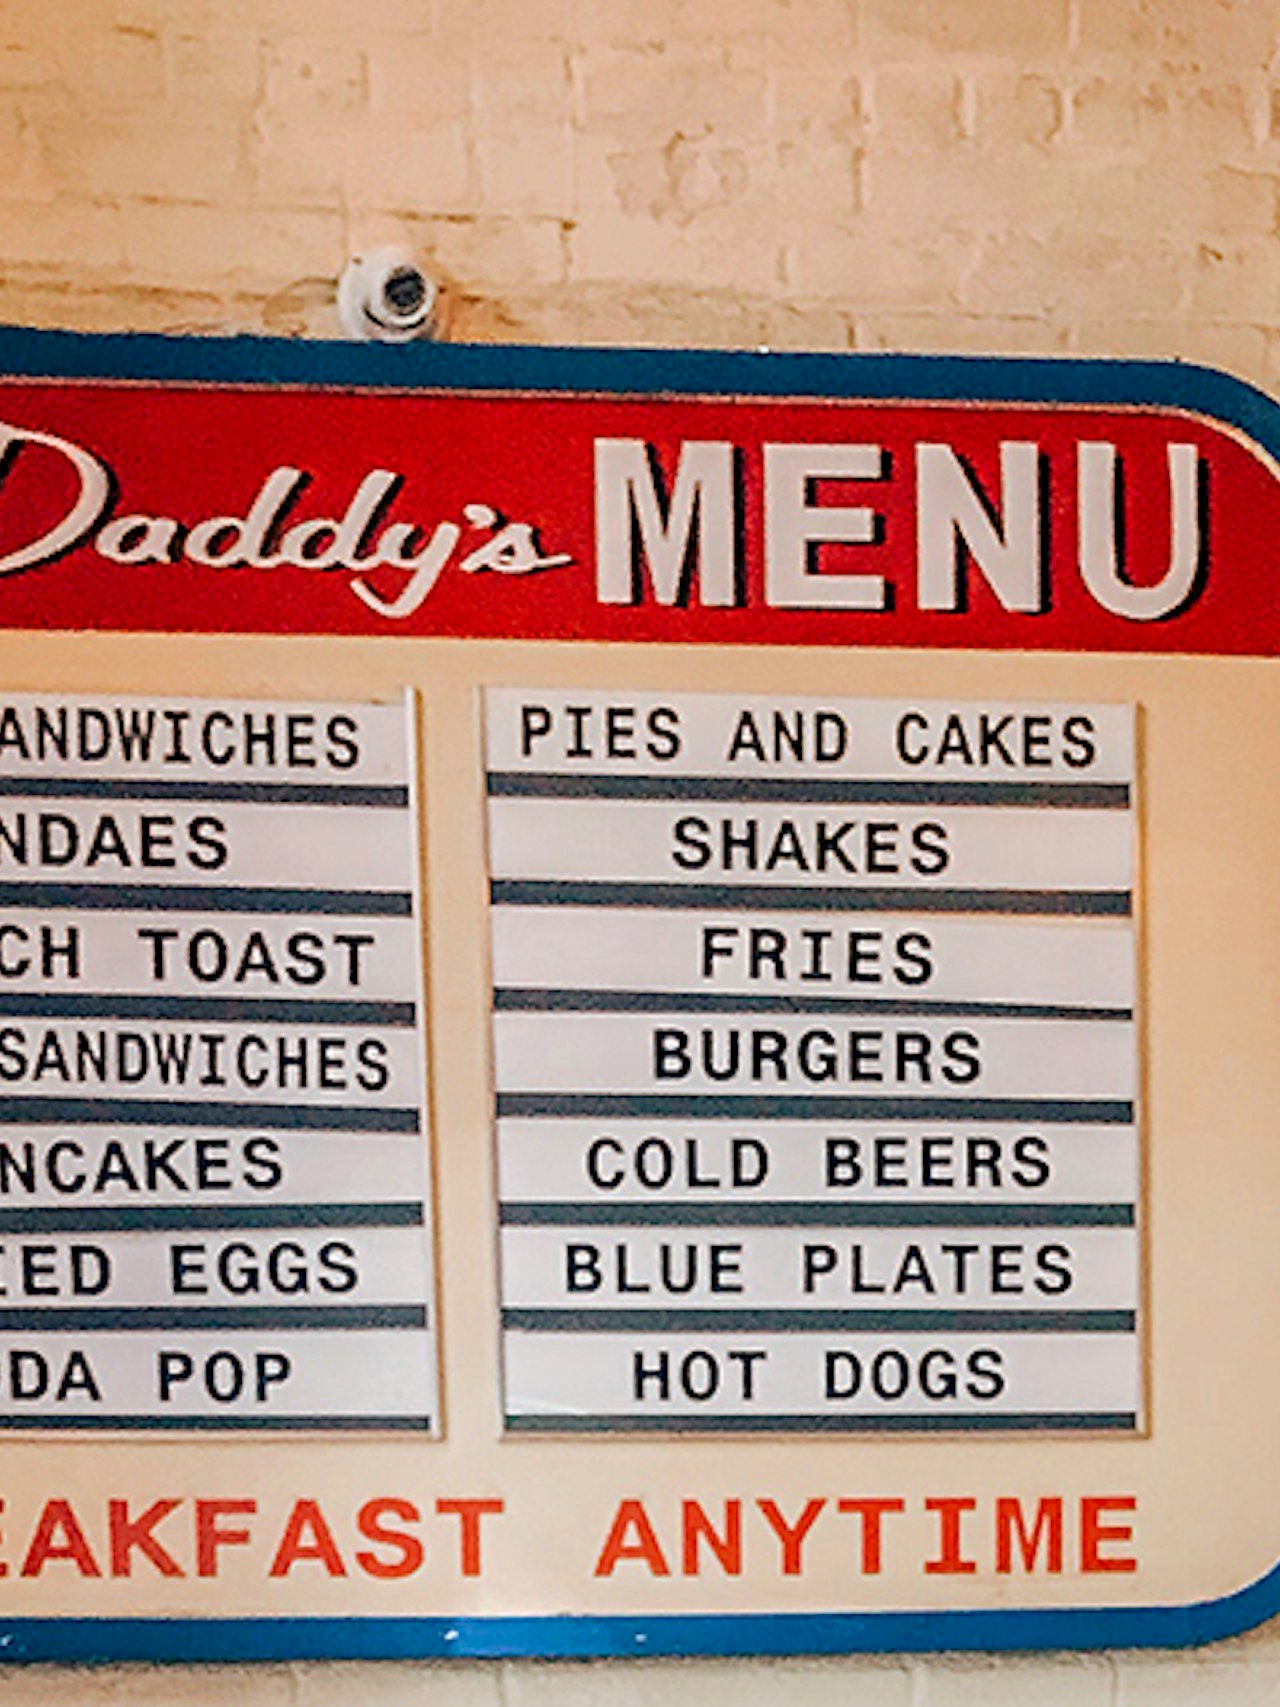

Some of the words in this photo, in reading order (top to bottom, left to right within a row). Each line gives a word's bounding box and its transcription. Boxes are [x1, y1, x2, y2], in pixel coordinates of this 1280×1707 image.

[593, 436, 1209, 621] MENU
[522, 706, 680, 760] PIES
[729, 711, 847, 762] AND
[897, 714, 1094, 767] CAKES
[673, 817, 948, 875] SHAKES
[138, 929, 374, 985] TOAST
[703, 928, 931, 985] FRIES
[654, 1029, 979, 1083] BURGERS
[588, 1138, 767, 1189] COLD
[827, 1137, 1049, 1187] BEERS
[171, 1242, 357, 1295] EGGS
[567, 1245, 742, 1293] BLUE
[804, 1245, 1071, 1294] PLATES
[159, 1352, 290, 1402] POP
[635, 1351, 766, 1400] HOT
[826, 1350, 1004, 1400] DOGS
[594, 1496, 1138, 1577] ANYTIME
